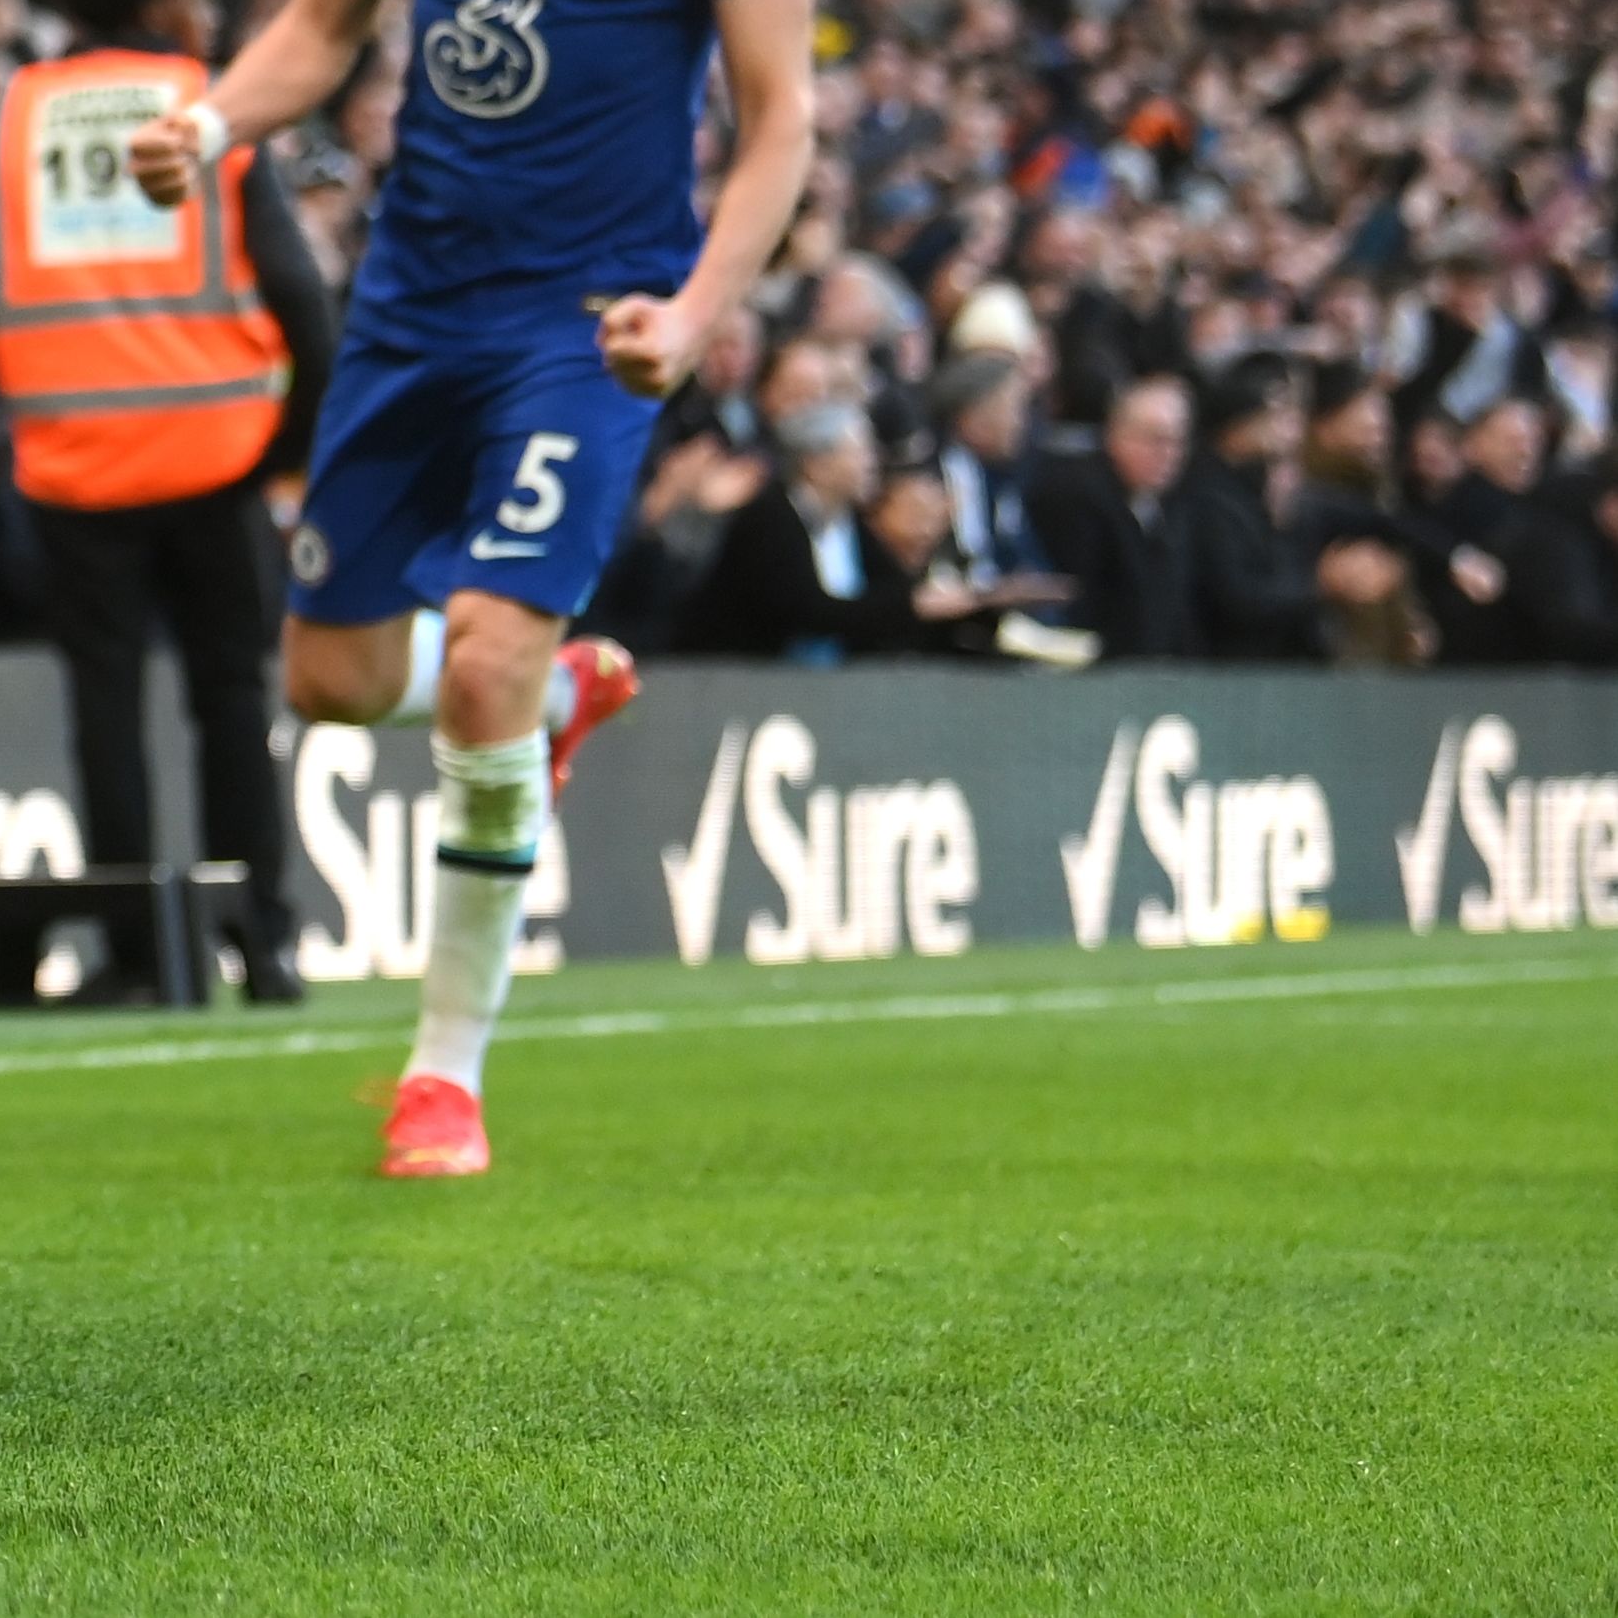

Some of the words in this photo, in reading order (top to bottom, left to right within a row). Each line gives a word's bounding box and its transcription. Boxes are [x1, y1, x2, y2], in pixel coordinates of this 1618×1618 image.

[495, 430, 579, 534] 5
[743, 713, 980, 965] Sure
[1134, 712, 1335, 949] Sure
